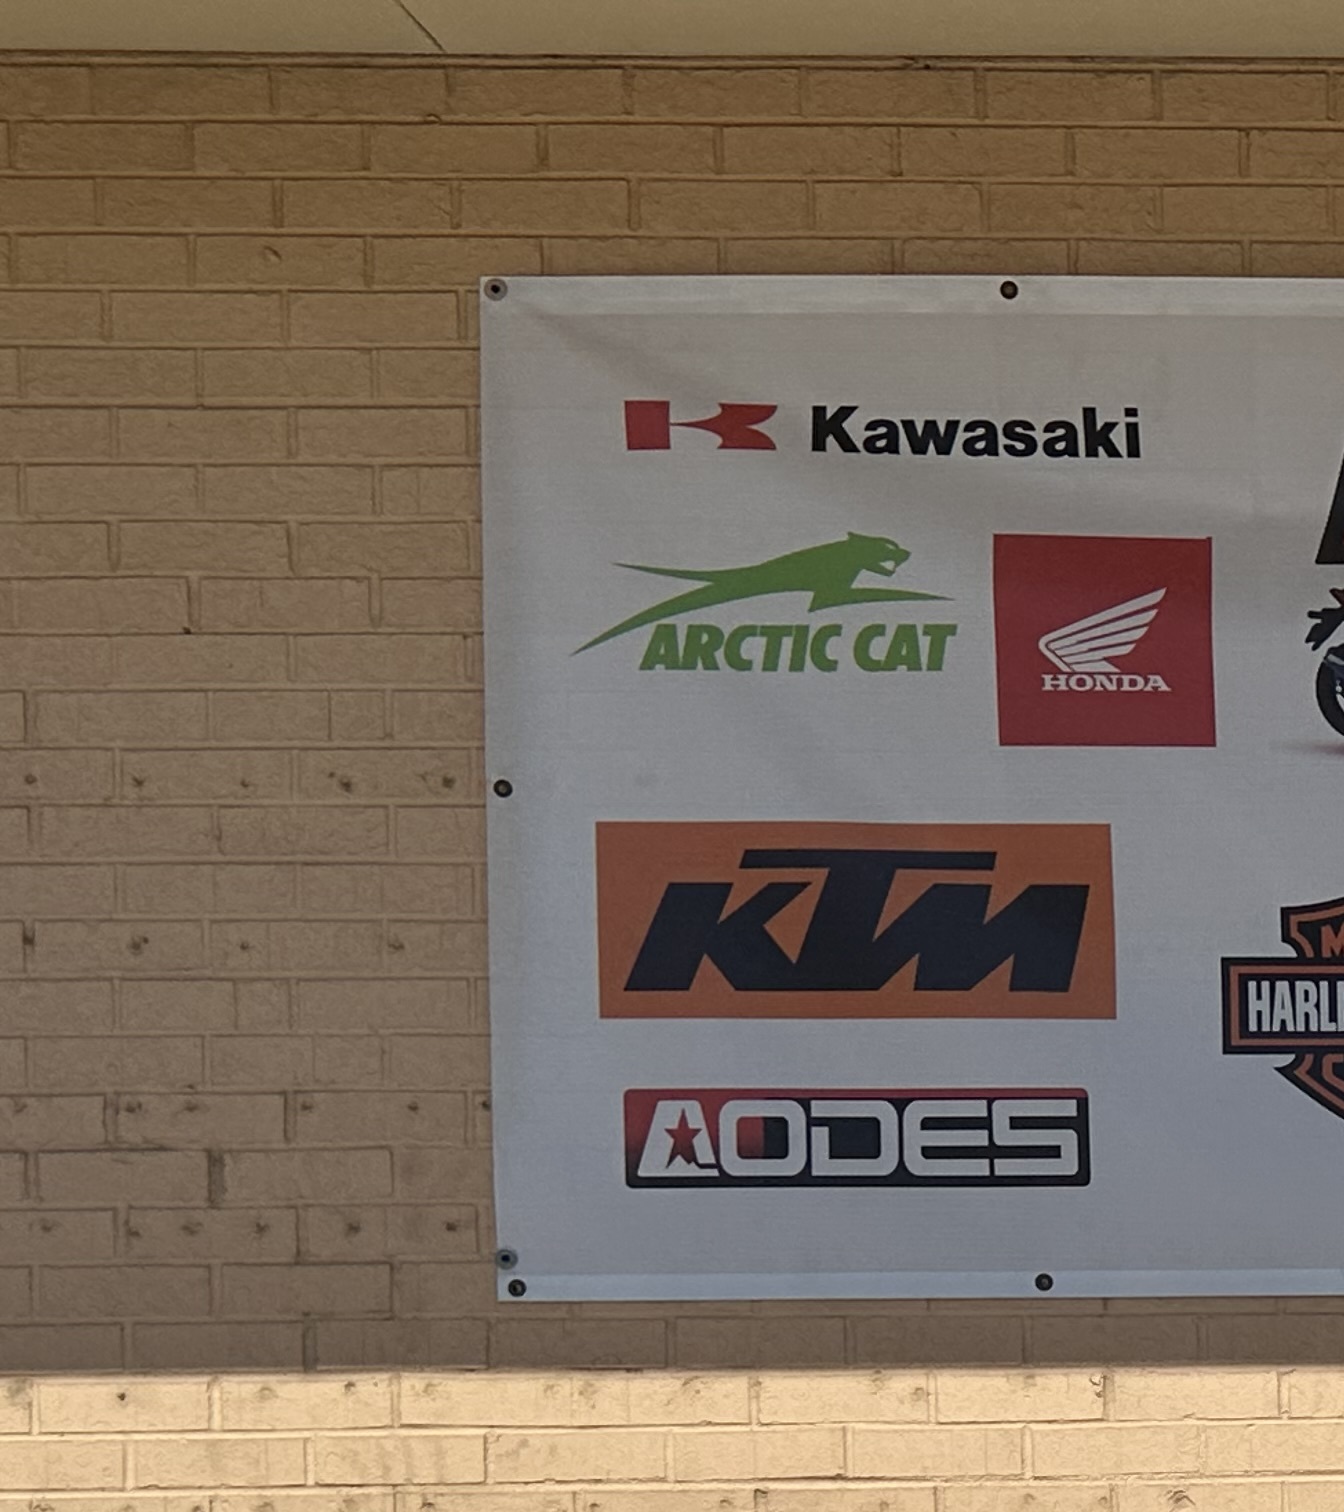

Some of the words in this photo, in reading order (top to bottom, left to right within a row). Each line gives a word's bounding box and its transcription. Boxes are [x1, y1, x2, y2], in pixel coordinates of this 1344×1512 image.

[811, 405, 1141, 459] Kawasaki
[638, 623, 843, 672] ARCTIC
[853, 623, 958, 672] CAT
[1041, 673, 1172, 692] HONDA
[623, 848, 1091, 993] KTM
[636, 1098, 1079, 1178] AODES
